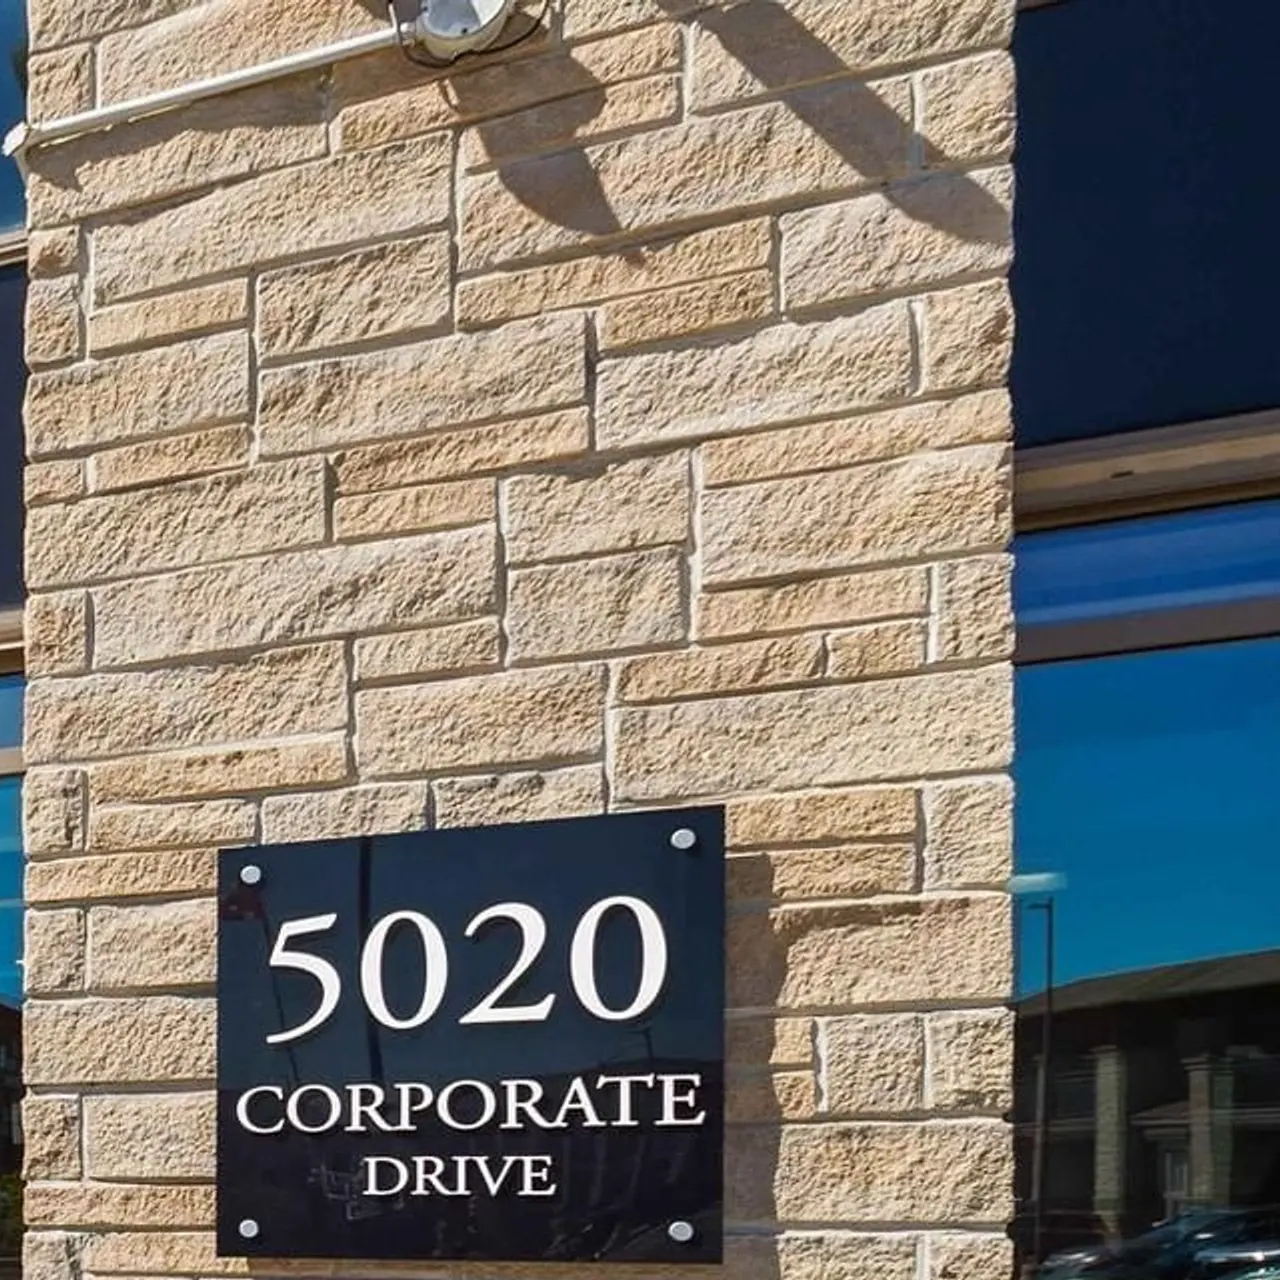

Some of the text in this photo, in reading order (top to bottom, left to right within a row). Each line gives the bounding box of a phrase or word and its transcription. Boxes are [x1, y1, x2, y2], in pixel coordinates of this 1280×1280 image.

[265, 895, 668, 1044] 5020
[235, 1073, 706, 1135] CORPORATE
[362, 1154, 558, 1198] DRIVE
